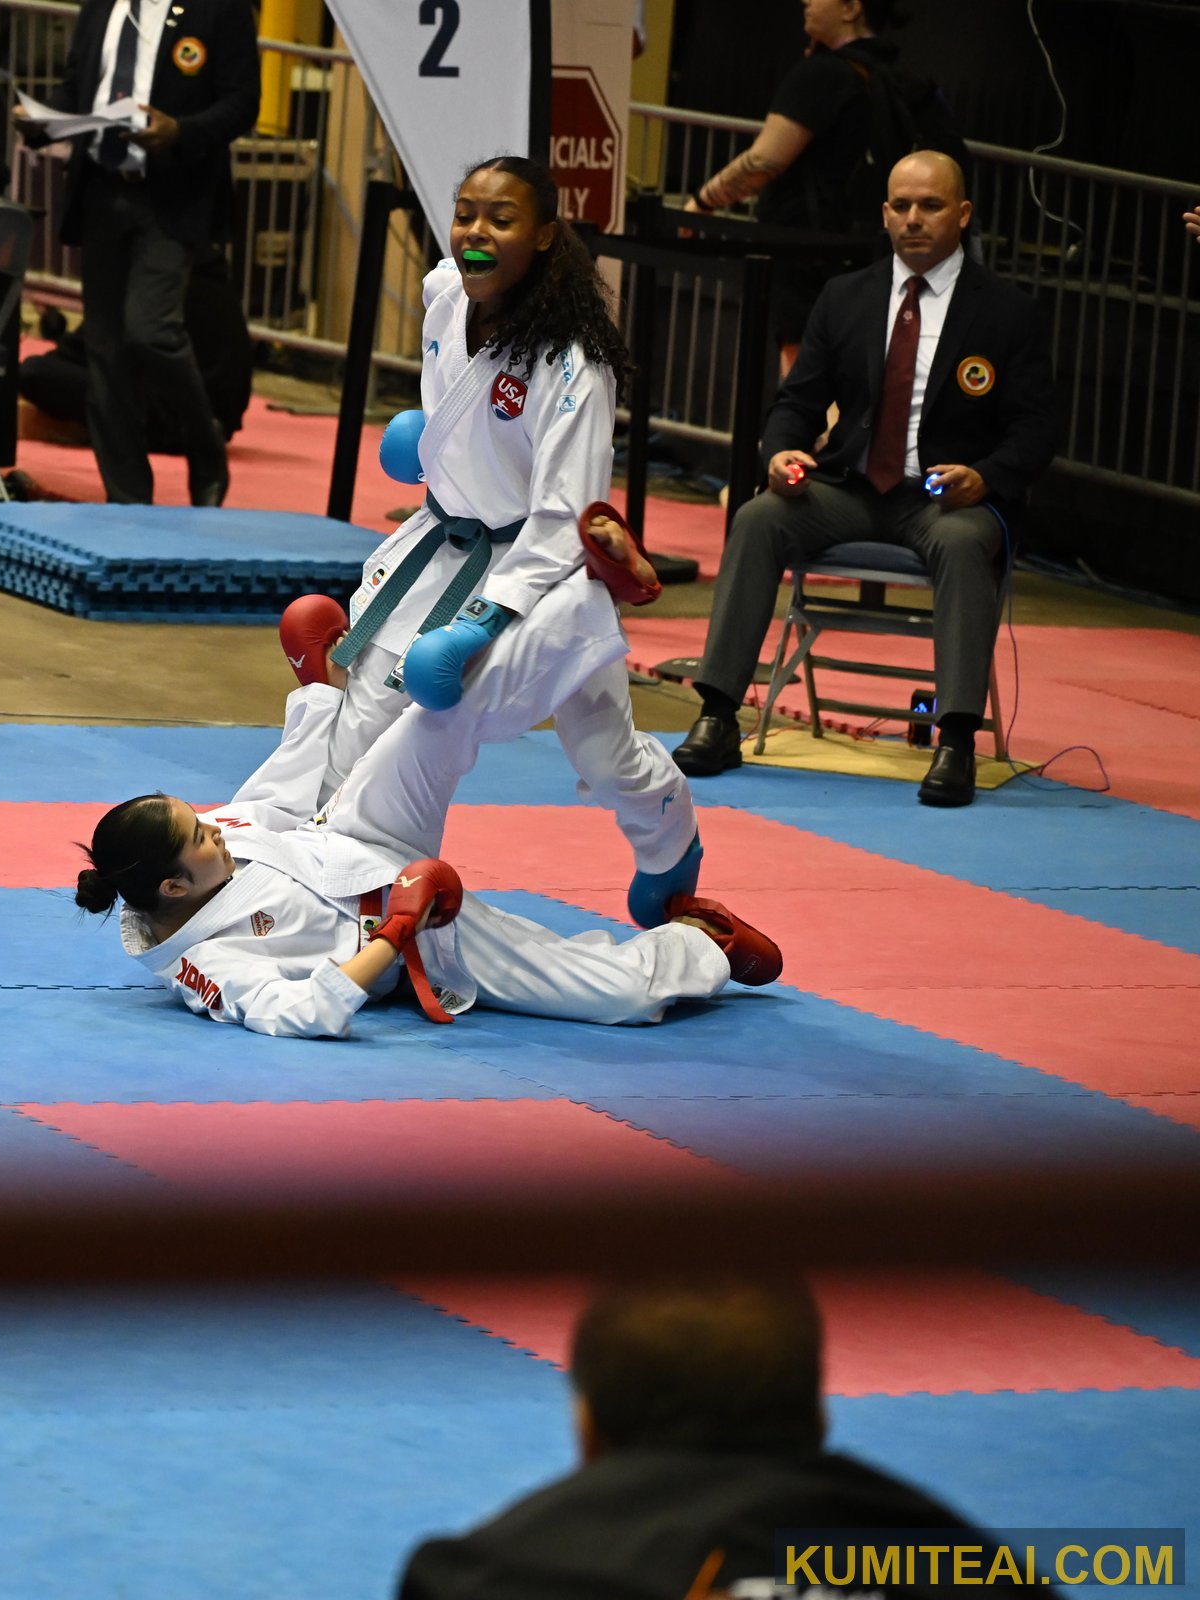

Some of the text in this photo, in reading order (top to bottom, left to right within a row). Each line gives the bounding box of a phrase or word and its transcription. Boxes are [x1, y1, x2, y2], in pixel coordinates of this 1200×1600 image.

[419, 0, 460, 77] 2
[550, 136, 614, 169] ICIALS
[498, 378, 525, 409] USA
